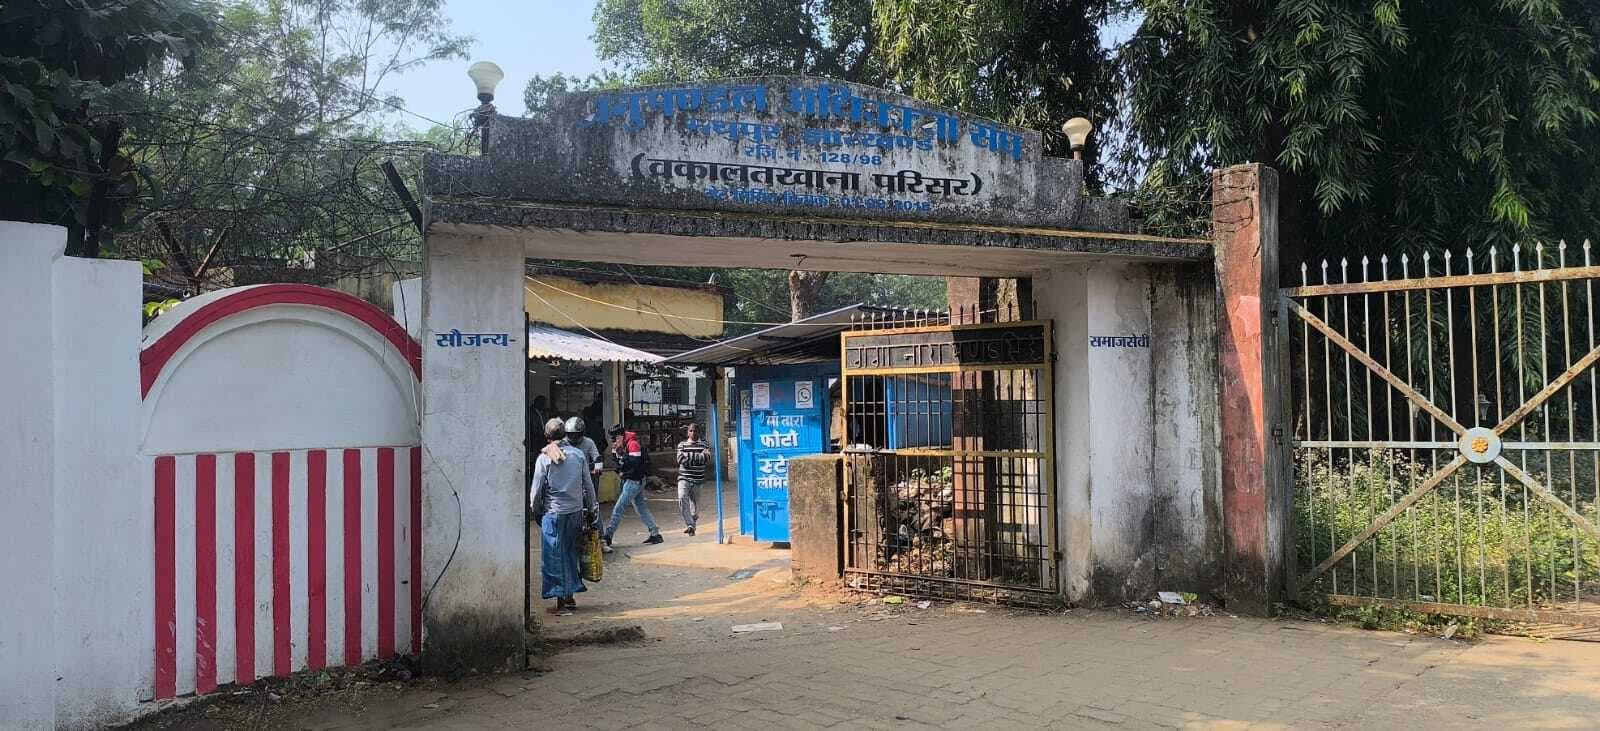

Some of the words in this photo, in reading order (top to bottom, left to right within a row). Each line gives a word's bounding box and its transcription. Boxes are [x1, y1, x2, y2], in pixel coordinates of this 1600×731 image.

[821, 150, 882, 166] 128/98
[631, 152, 862, 190] (वकालतखाना
[871, 169, 983, 197] परिसर)
[1089, 333, 1150, 348] समाजसेवी
[760, 430, 799, 448] फोटो
[759, 455, 789, 475] स्टे
